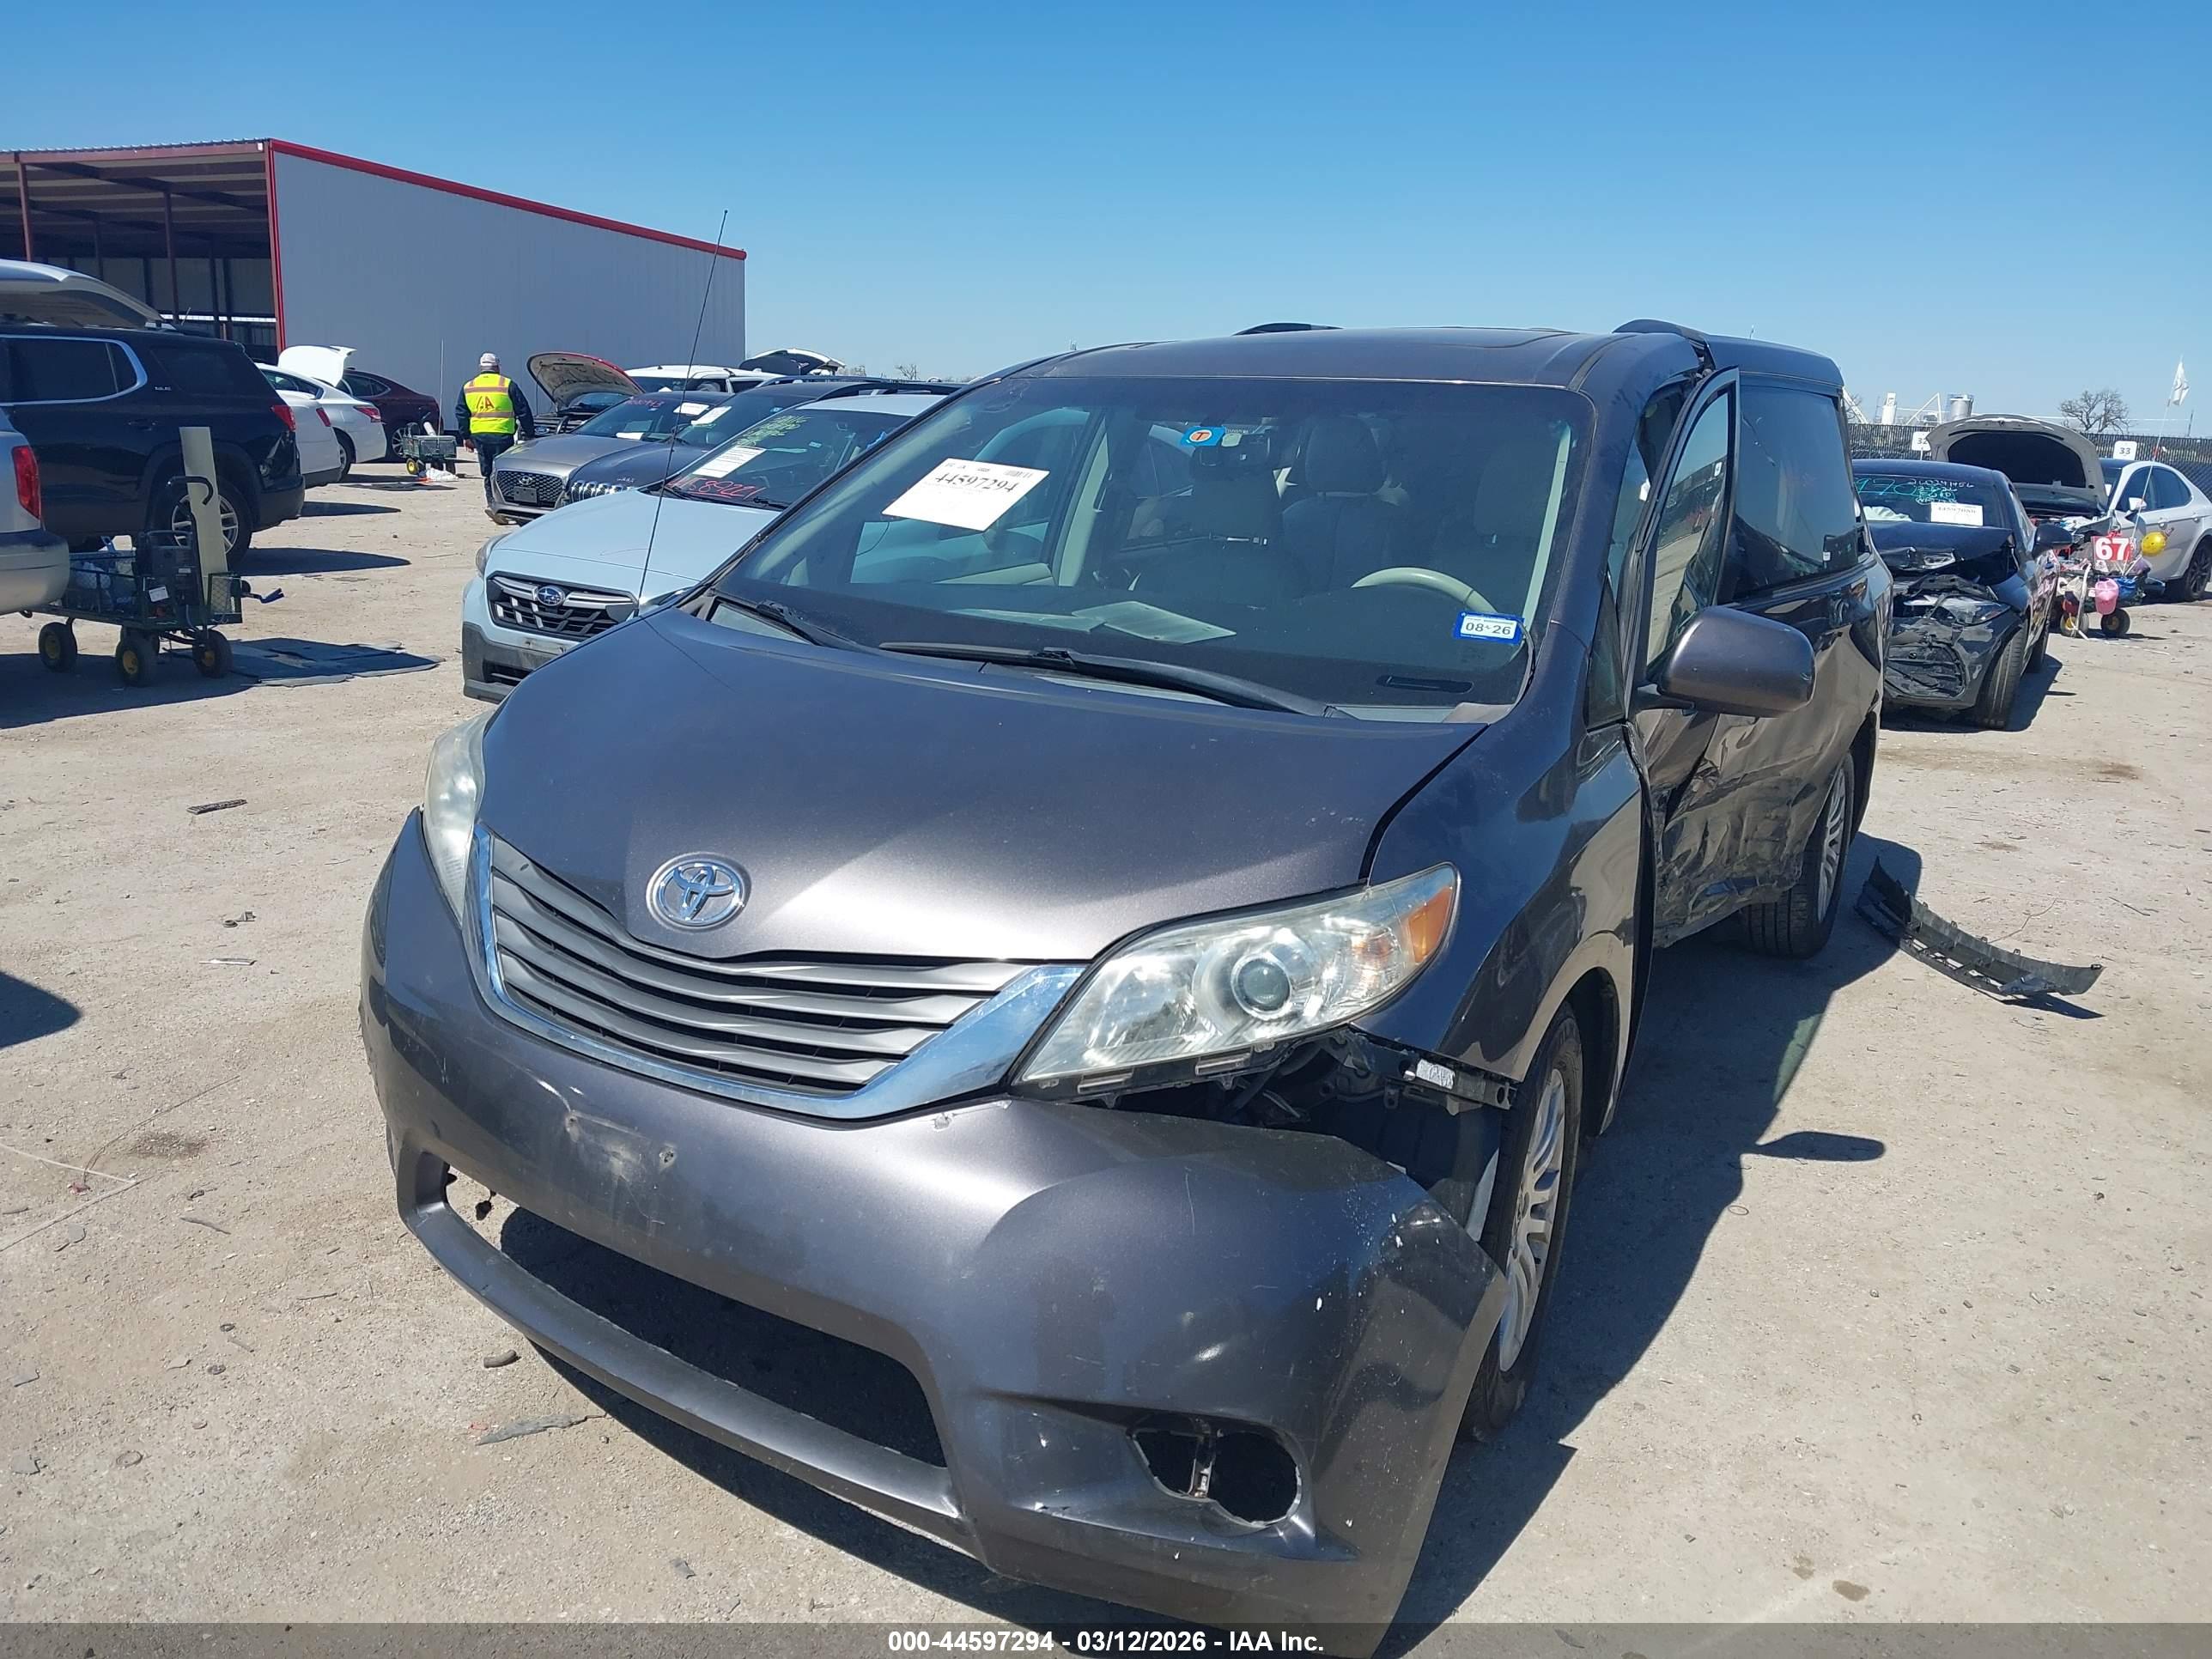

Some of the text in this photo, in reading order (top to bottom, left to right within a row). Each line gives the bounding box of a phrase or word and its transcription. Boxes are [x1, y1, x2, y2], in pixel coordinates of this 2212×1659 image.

[2118, 447, 2131, 455] 33
[934, 472, 1020, 493] 44597294
[2095, 537, 2130, 561] 67
